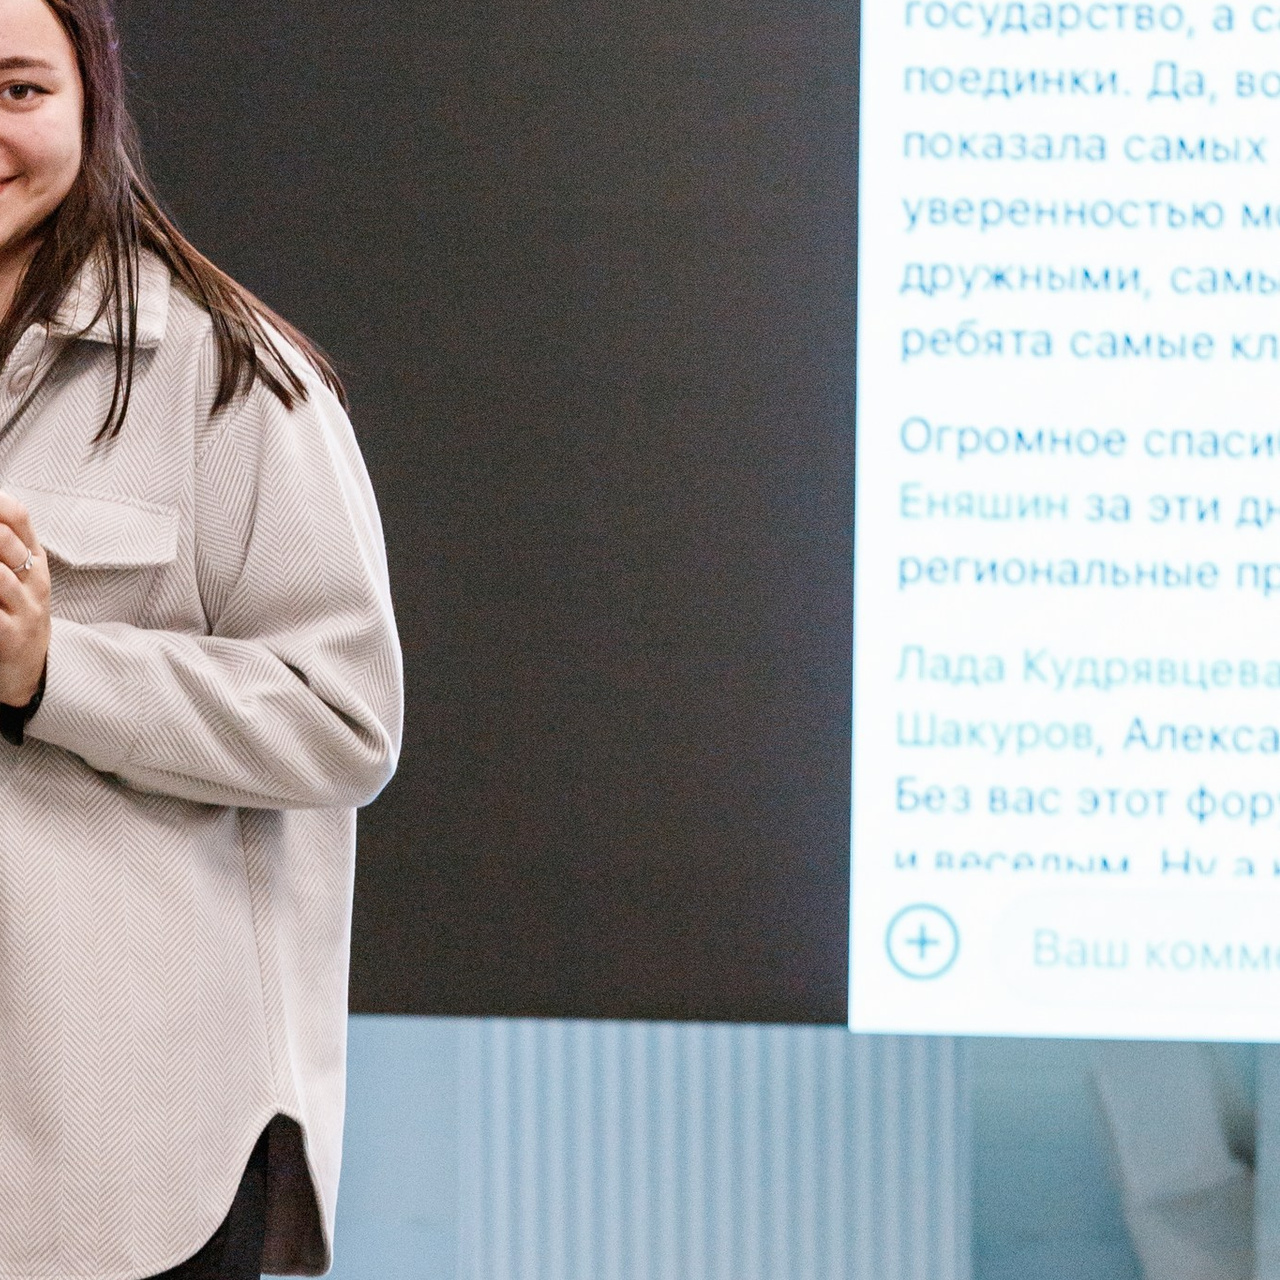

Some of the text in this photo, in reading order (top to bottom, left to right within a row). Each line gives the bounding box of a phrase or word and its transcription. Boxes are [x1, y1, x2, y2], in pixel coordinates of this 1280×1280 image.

[905, 0, 1195, 39] государство,
[1251, 4, 1280, 33] с
[904, 66, 1130, 100] поединки.
[1146, 60, 1217, 105] Да,
[903, 131, 1266, 164] показала самых
[902, 197, 1280, 233] уверенностью м
[899, 262, 1150, 300] дружными,
[901, 319, 1280, 363] ребята самые кл
[899, 415, 1280, 461] Огромное спаси
[899, 481, 1069, 522] Еняшин
[1086, 494, 1132, 523] за
[1150, 494, 1220, 524] эти
[898, 556, 1220, 591] региональные
[896, 644, 1280, 693] Лада Кудрявцева
[897, 712, 1280, 758] Шакуров, Алекса
[896, 775, 1280, 826] Без вас этот фор
[1032, 927, 1280, 972] Ваш комм
